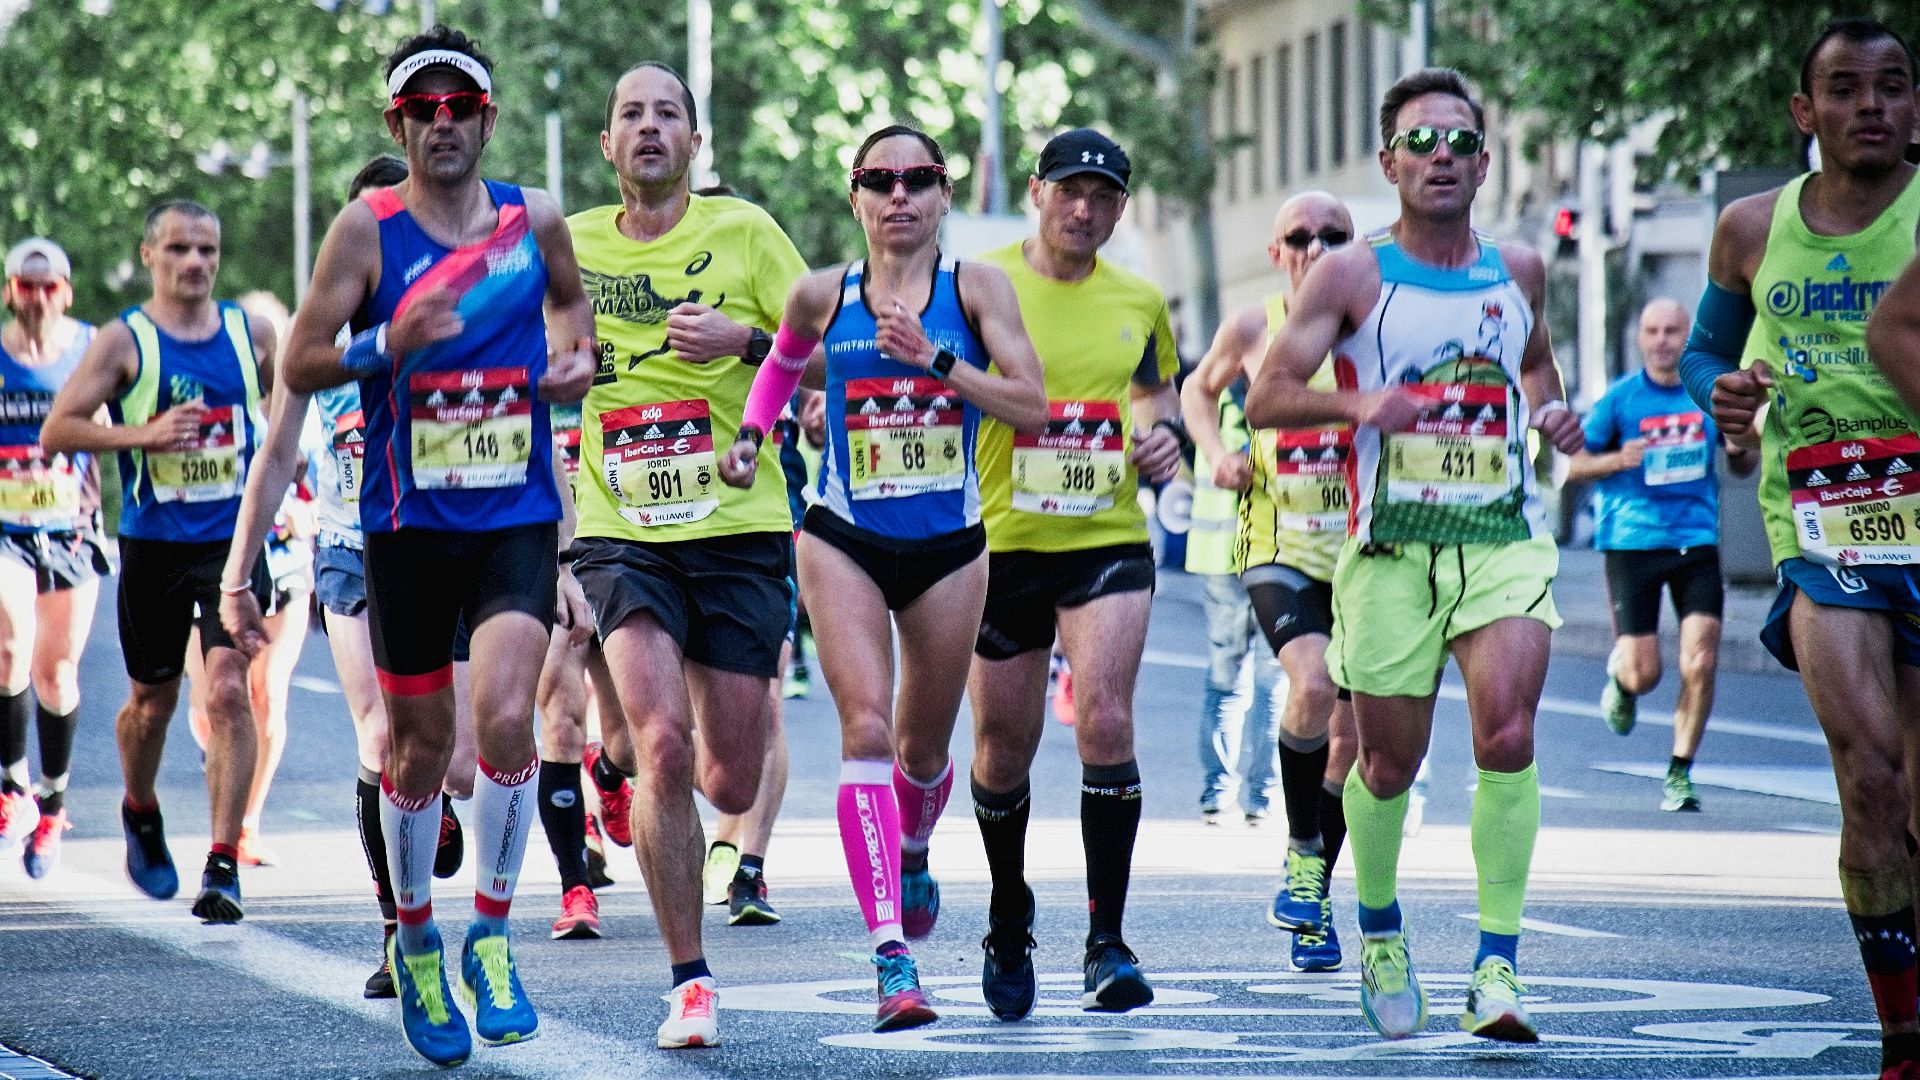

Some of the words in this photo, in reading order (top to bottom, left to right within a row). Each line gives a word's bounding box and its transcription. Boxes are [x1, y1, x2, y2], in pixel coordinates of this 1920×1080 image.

[641, 406, 662, 421] edp
[1837, 415, 1908, 434] Banplus
[464, 432, 499, 460] 146
[870, 443, 881, 474] F
[902, 442, 926, 470] 68
[1841, 443, 1866, 460] edp
[181, 458, 218, 483] 5280
[647, 458, 671, 469] JORDI
[1441, 450, 1475, 478] 431
[648, 469, 683, 500] 901
[1062, 464, 1095, 491] 388
[655, 511, 694, 521] HUAWEI
[1845, 501, 1891, 517] ZANCUDO
[1849, 513, 1906, 542] 6590
[1864, 553, 1912, 561] HUAWEI
[495, 789, 521, 875] COMPRESSPORT
